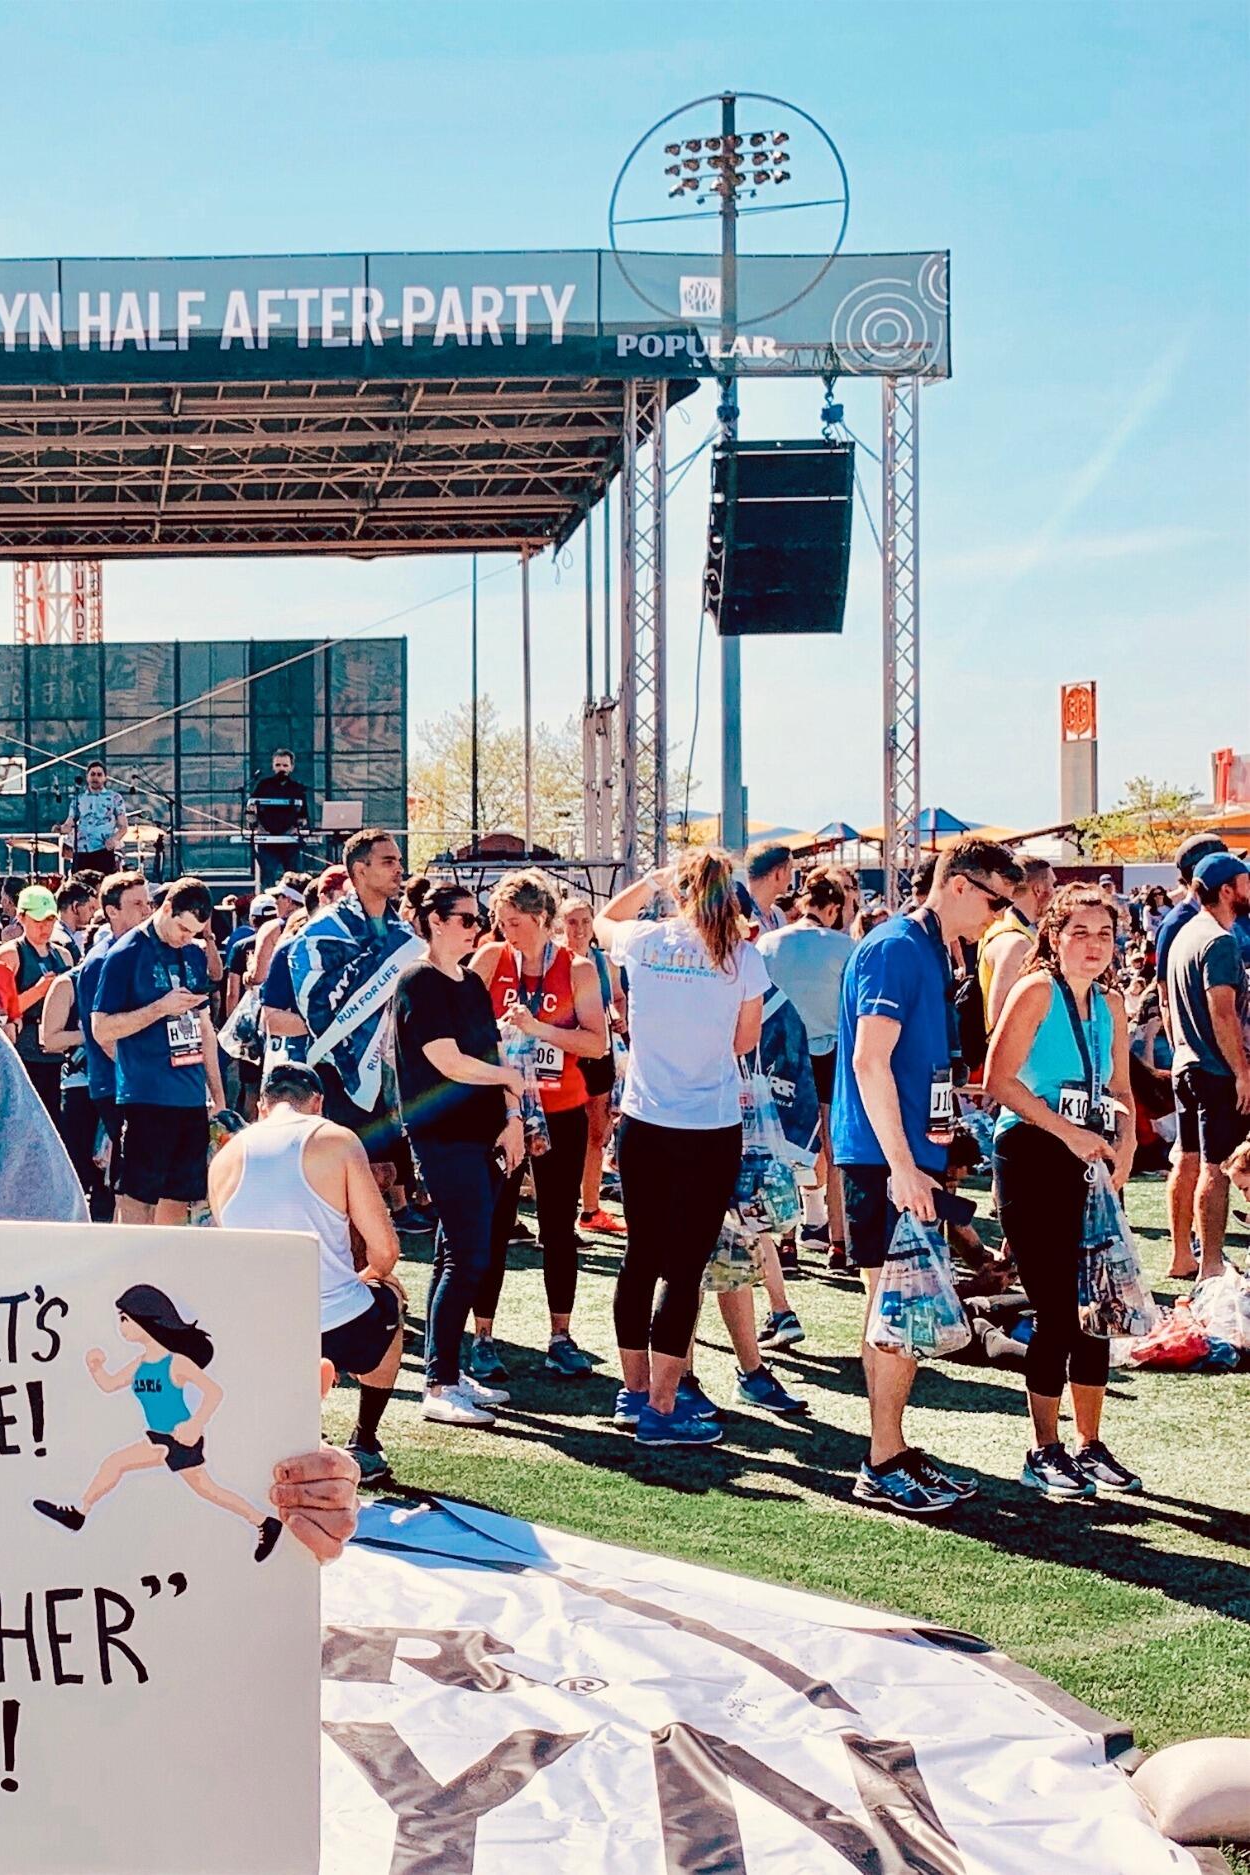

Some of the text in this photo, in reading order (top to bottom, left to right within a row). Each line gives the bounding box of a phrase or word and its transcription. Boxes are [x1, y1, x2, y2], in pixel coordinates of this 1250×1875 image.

[78, 291, 205, 351] HALF
[220, 284, 576, 350] AFTER-PARTY
[616, 333, 780, 359] POPULAR
[336, 963, 400, 1025] RUN FOR LIFE
